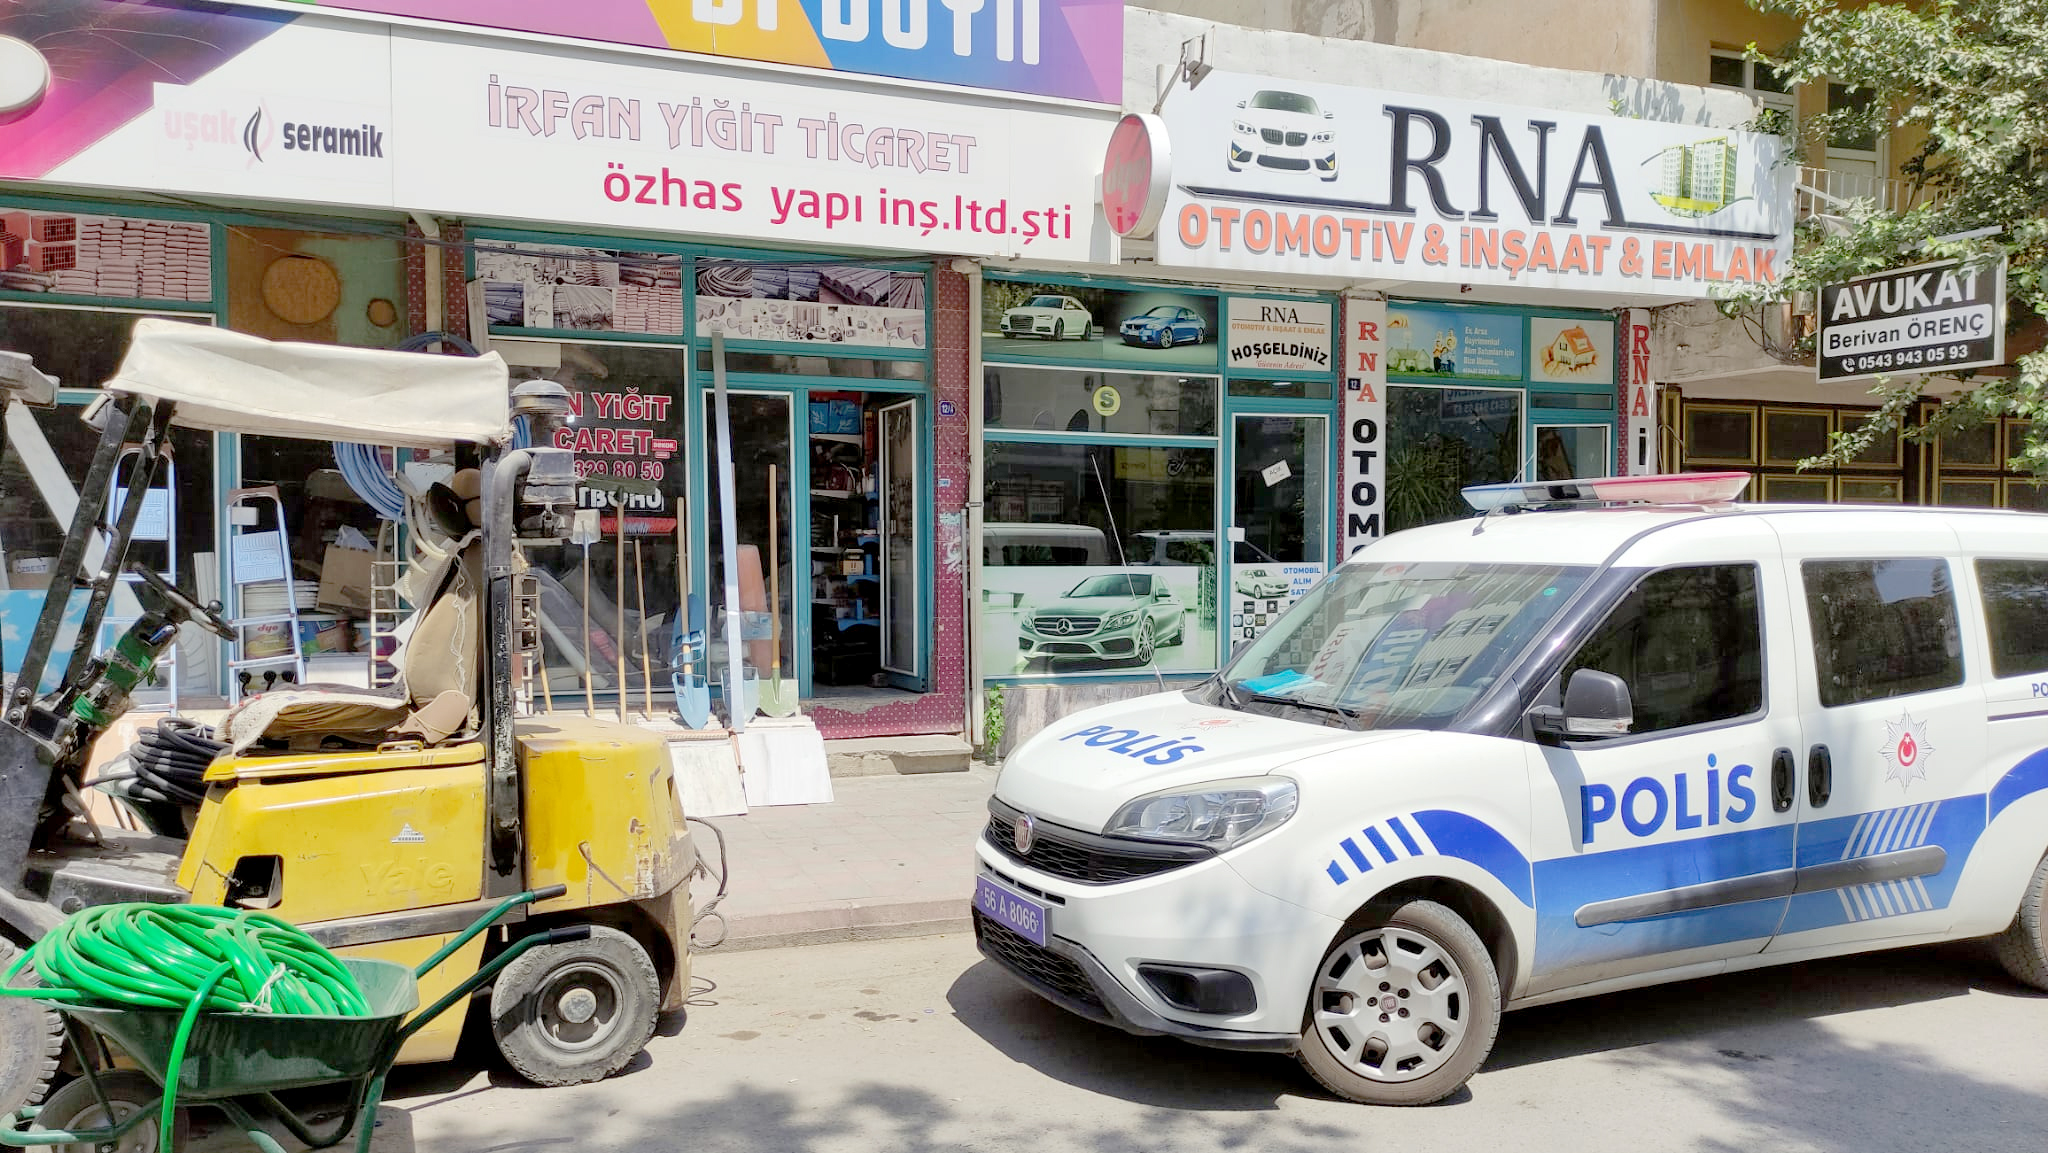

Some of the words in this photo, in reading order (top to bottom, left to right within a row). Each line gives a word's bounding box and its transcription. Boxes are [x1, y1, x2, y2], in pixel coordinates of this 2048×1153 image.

[164, 109, 237, 151] uşak
[283, 122, 384, 158] seramik
[488, 73, 641, 141] İRFAN
[657, 95, 784, 155] YİĞİT
[797, 112, 977, 174] TİCARET
[1382, 103, 1628, 231] RNA
[603, 161, 743, 212] özhas
[770, 186, 863, 229] yapı
[1422, 223, 1449, 266] &
[1619, 236, 1644, 278] &
[1652, 239, 1778, 284] EMLAK
[1261, 306, 1299, 324] RNA
[1829, 328, 1900, 350] Berivan
[1907, 313, 1985, 340] ÖRENÇ
[1231, 342, 1328, 366] HOŞGELDİNİZ
[1858, 354, 1893, 370] 0543
[1896, 350, 1923, 365] 943
[1927, 347, 1945, 362] 05
[1949, 344, 1968, 359] 93
[553, 427, 653, 455] CARET
[613, 460, 637, 479] 80
[641, 460, 664, 480] 50
[1293, 577, 1312, 585] ALIM
[1058, 725, 1205, 766] POLİS
[1580, 753, 1756, 845] POLİS
[360, 857, 456, 898] Yale
[984, 885, 997, 911] 56
[999, 895, 1007, 918] A
[1010, 901, 1037, 934] 8066
